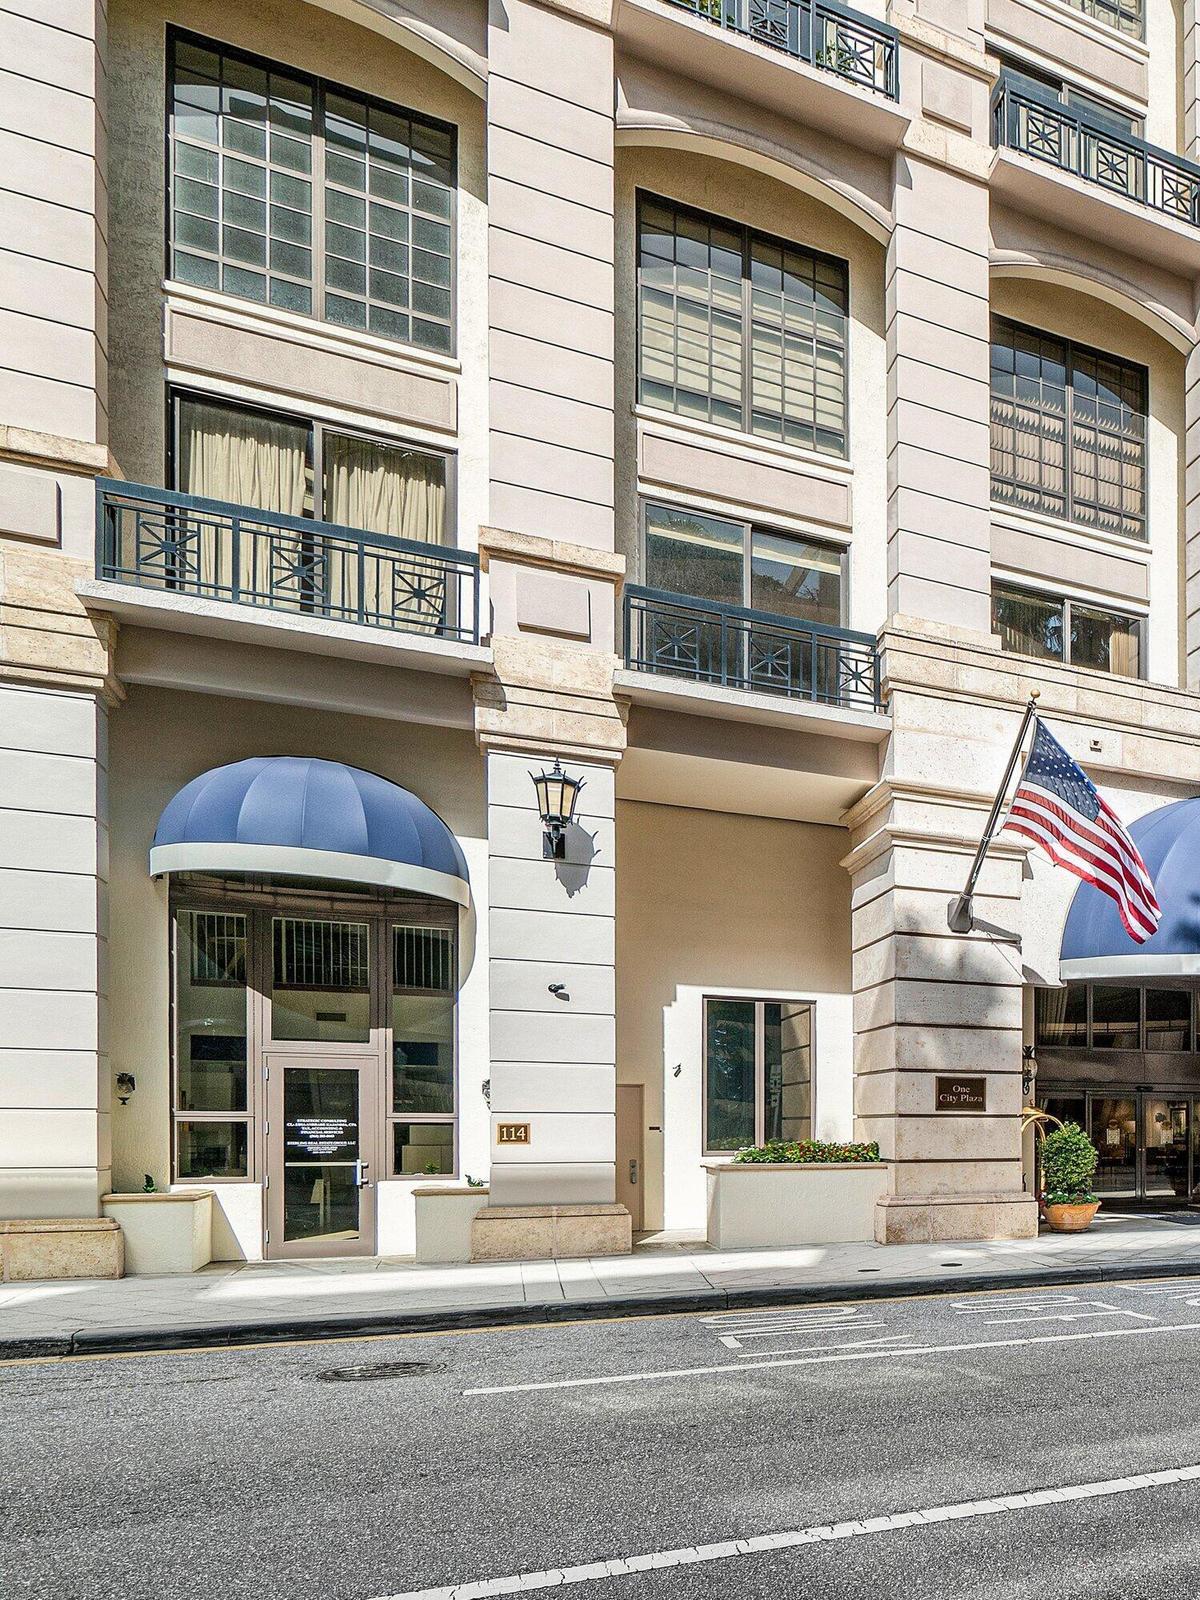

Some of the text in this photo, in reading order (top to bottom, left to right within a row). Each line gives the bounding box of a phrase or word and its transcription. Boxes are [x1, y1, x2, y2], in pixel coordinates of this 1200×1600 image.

[952, 1085, 970, 1093] One
[940, 1094, 983, 1103] City Plaza
[501, 1127, 526, 1140] 114
[949, 1295, 1158, 1325] OFF
[698, 1306, 934, 1358] ONLY
